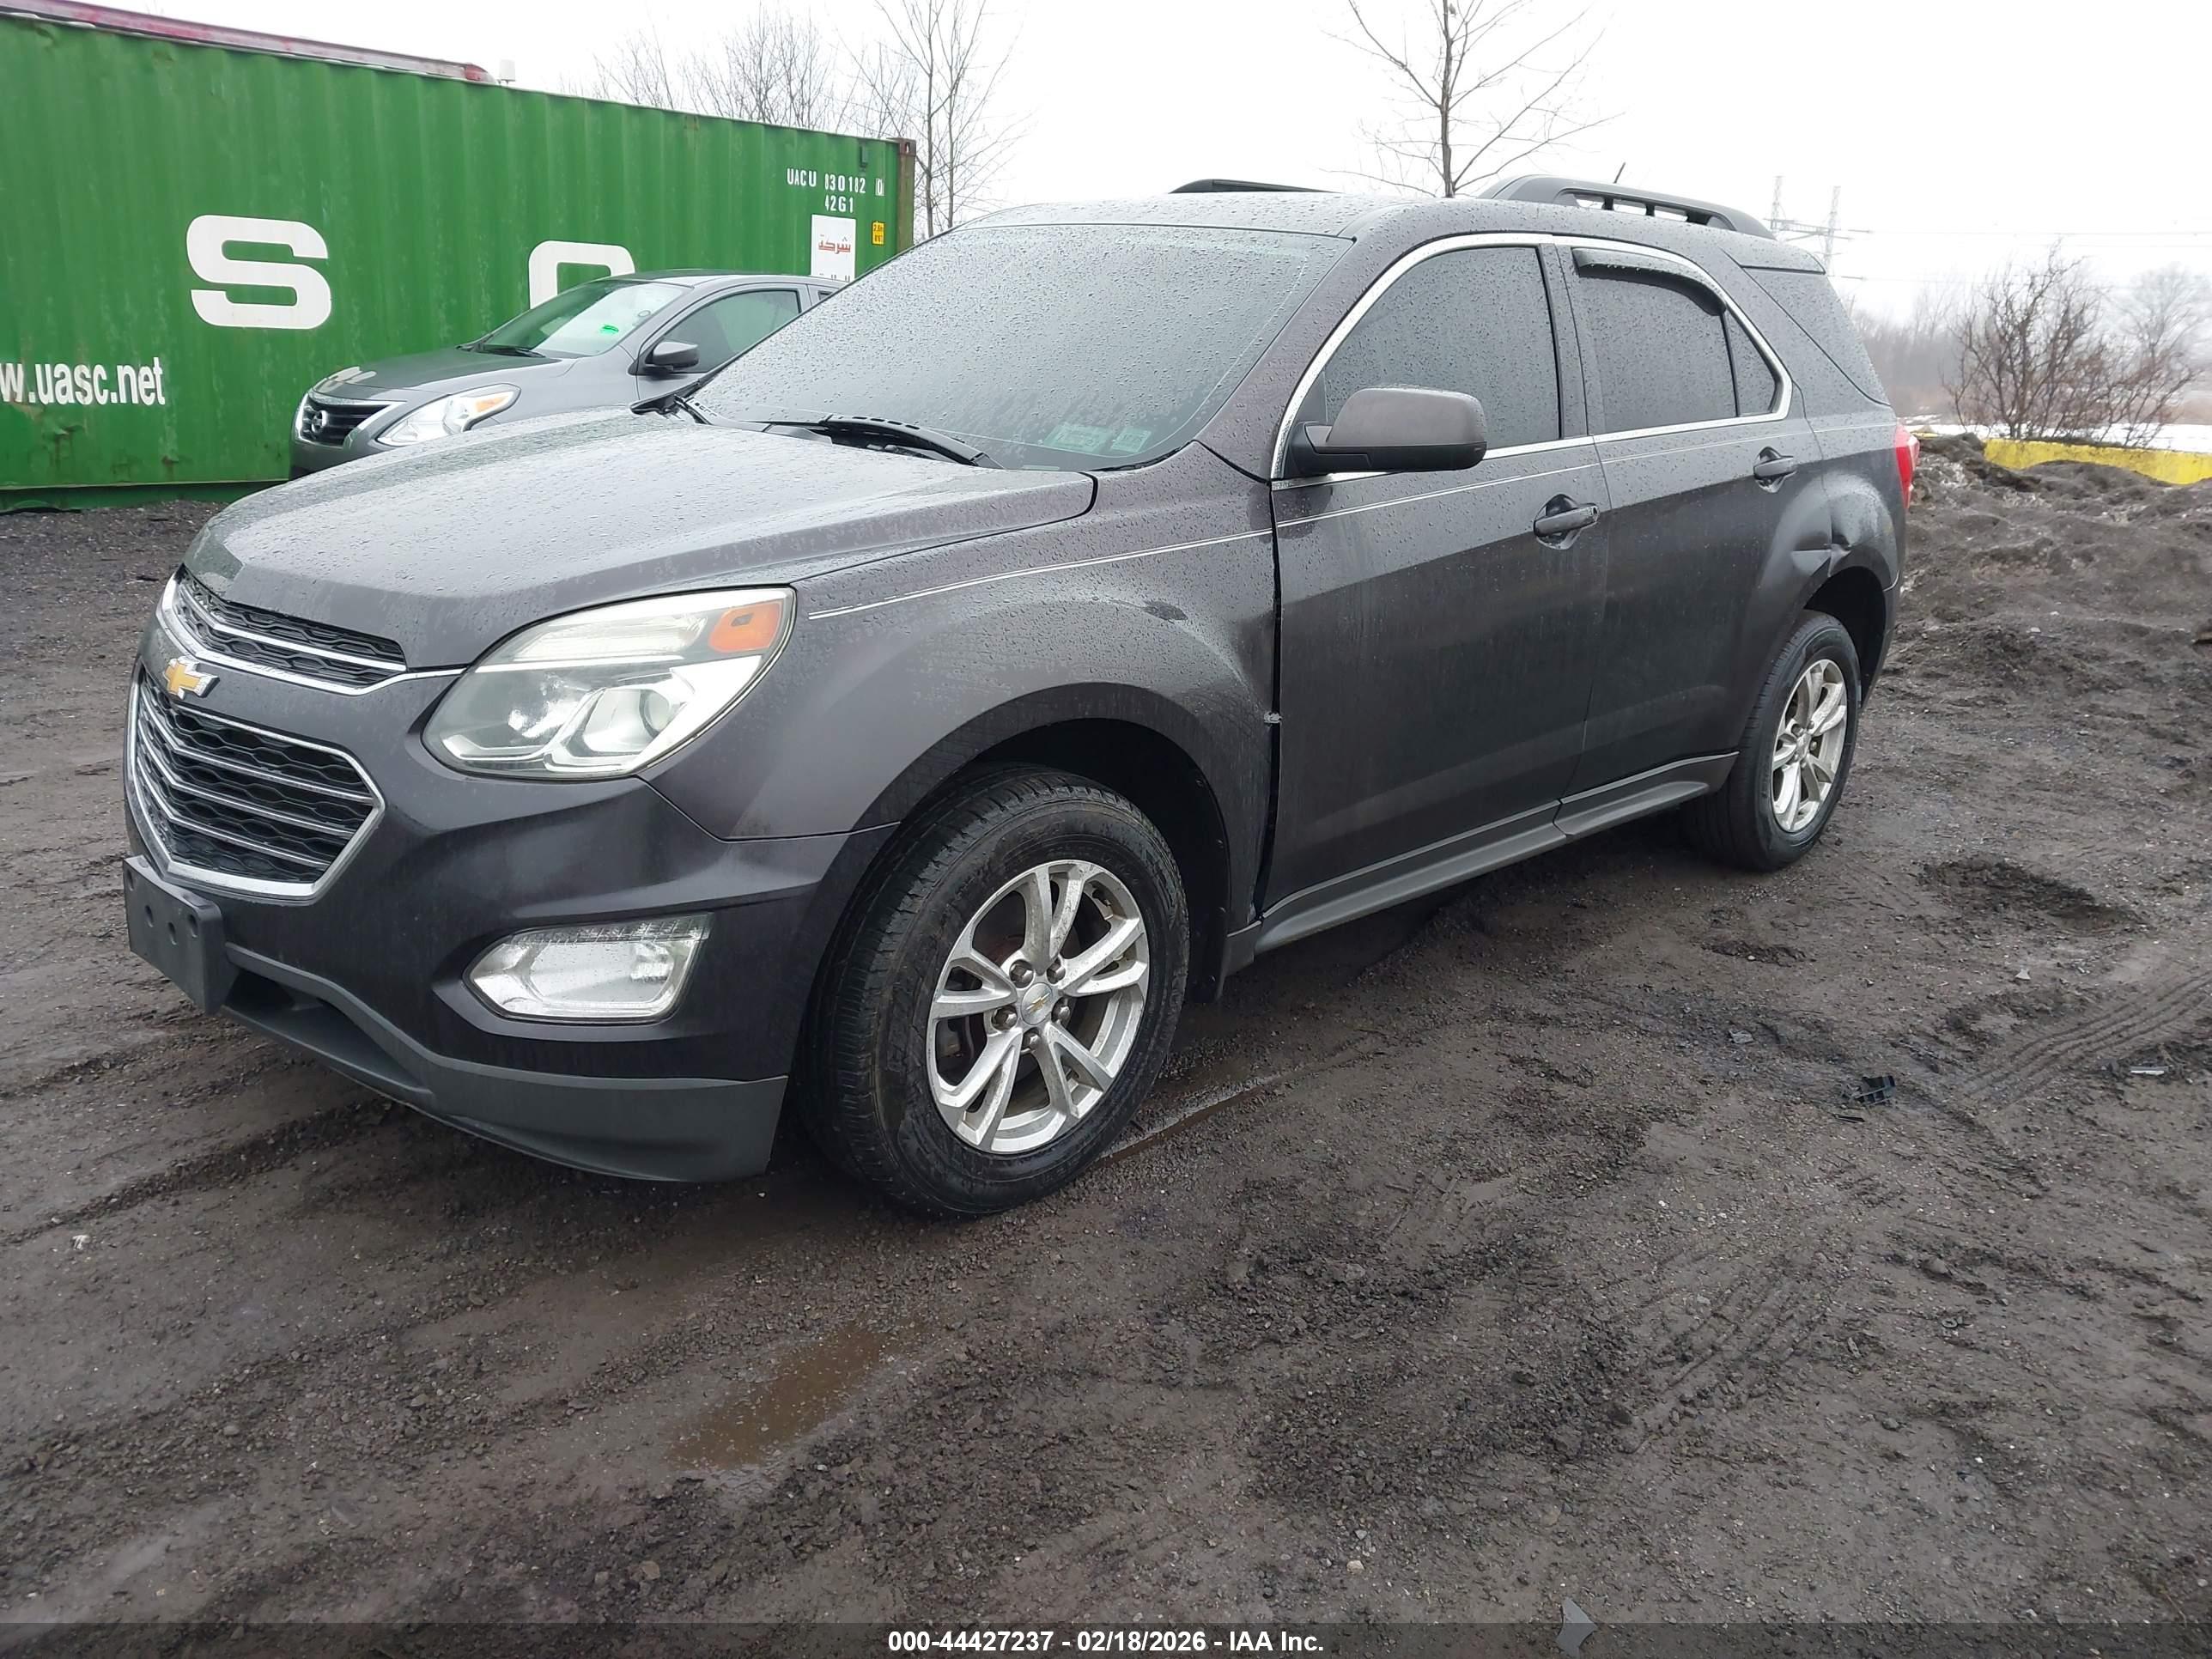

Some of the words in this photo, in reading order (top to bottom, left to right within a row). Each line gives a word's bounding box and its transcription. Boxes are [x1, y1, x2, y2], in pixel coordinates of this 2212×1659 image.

[787, 167, 817, 187] UACU
[824, 194, 854, 214] 42G1
[185, 215, 331, 329] S
